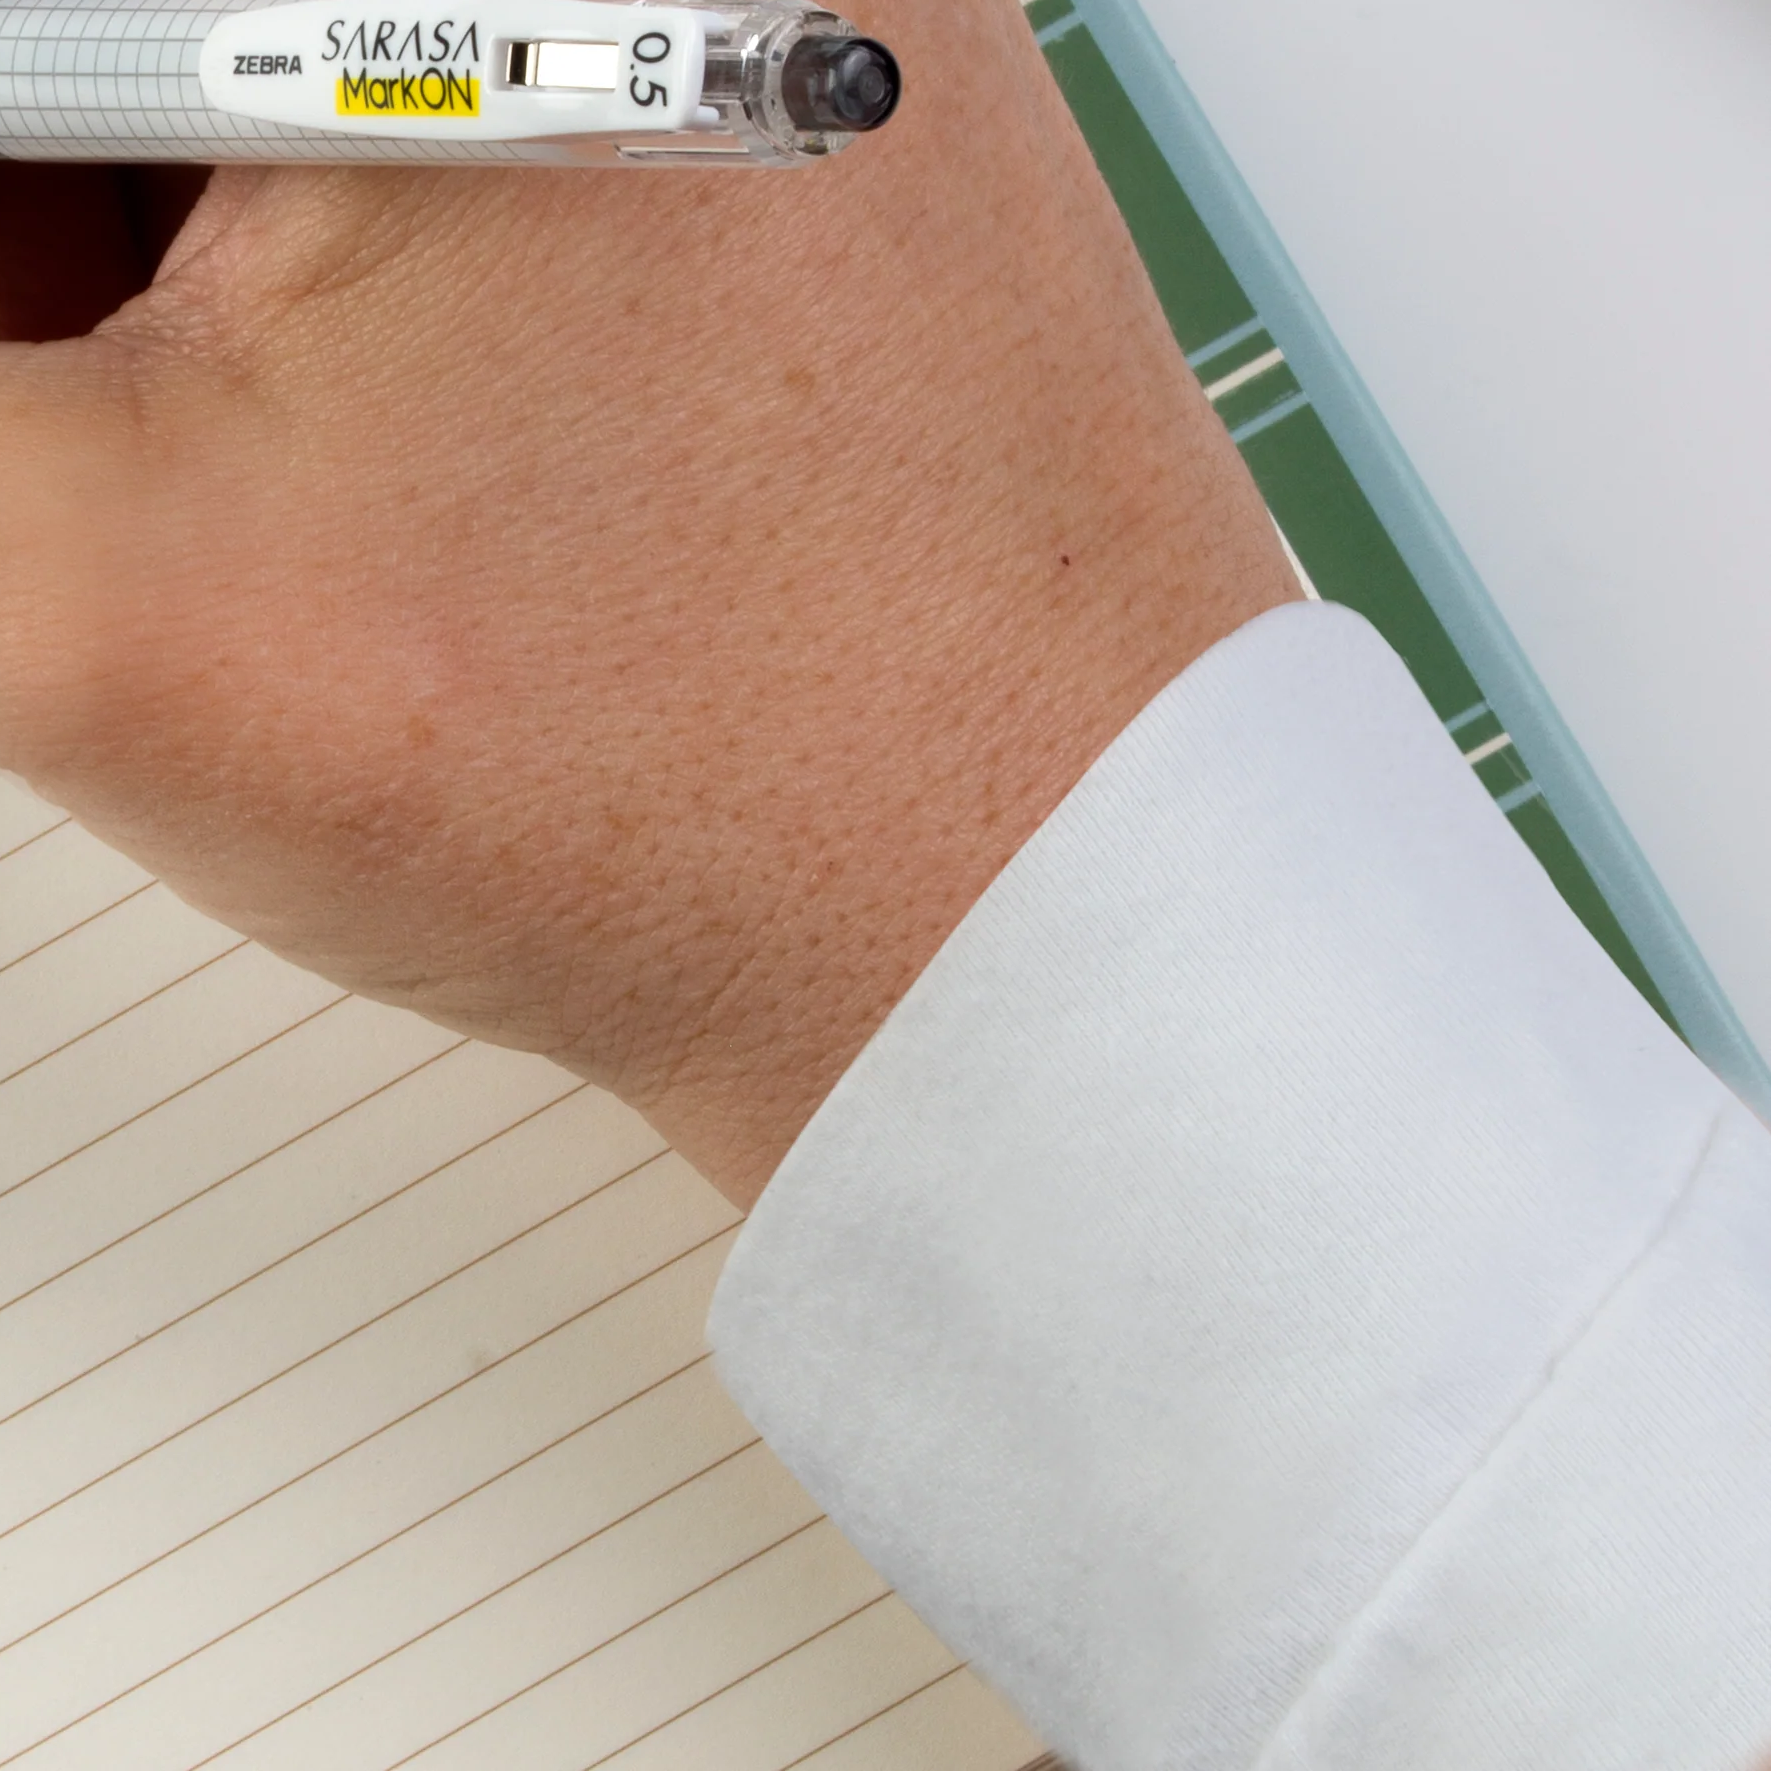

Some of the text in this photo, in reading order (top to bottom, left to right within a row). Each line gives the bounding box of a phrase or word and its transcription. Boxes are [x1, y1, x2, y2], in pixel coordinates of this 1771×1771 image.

[321, 18, 481, 63] SARASA
[232, 54, 303, 76] ZEBRA
[629, 30, 672, 109] 0.5
